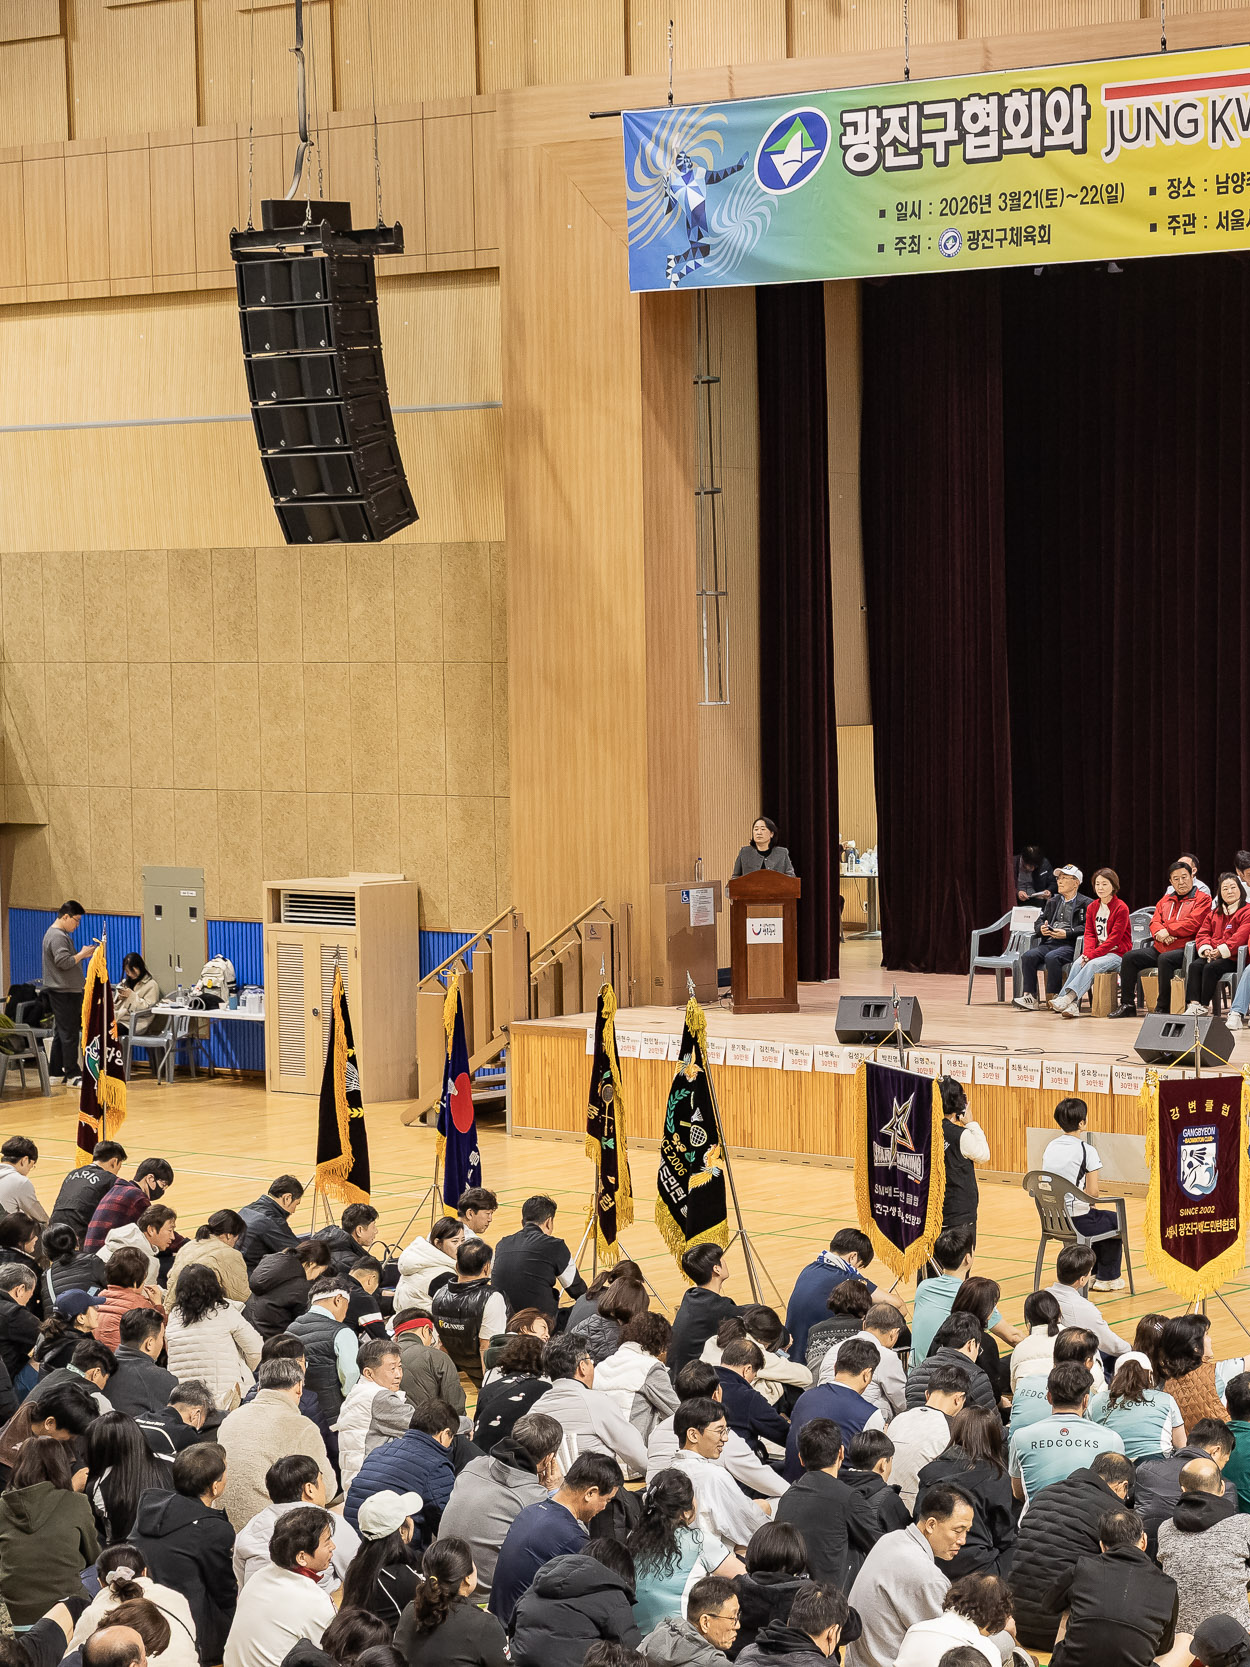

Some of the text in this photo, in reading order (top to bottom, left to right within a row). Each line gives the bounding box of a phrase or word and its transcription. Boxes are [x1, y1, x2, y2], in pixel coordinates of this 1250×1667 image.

[841, 86, 1088, 174] 광진구협회와
[1104, 102, 1199, 157] JUNG
[1166, 176, 1197, 200] 장소
[895, 182, 1125, 221] 일시 2026년 3월21(토)~22(일)
[1167, 212, 1198, 237] 주관
[894, 234, 921, 256] 주최
[968, 223, 1051, 252] 광진구체육회
[668, 1151, 688, 1177] 2006
[1180, 1205, 1216, 1217] SINCE 2002
[1031, 1439, 1099, 1450] REDCOCKS
